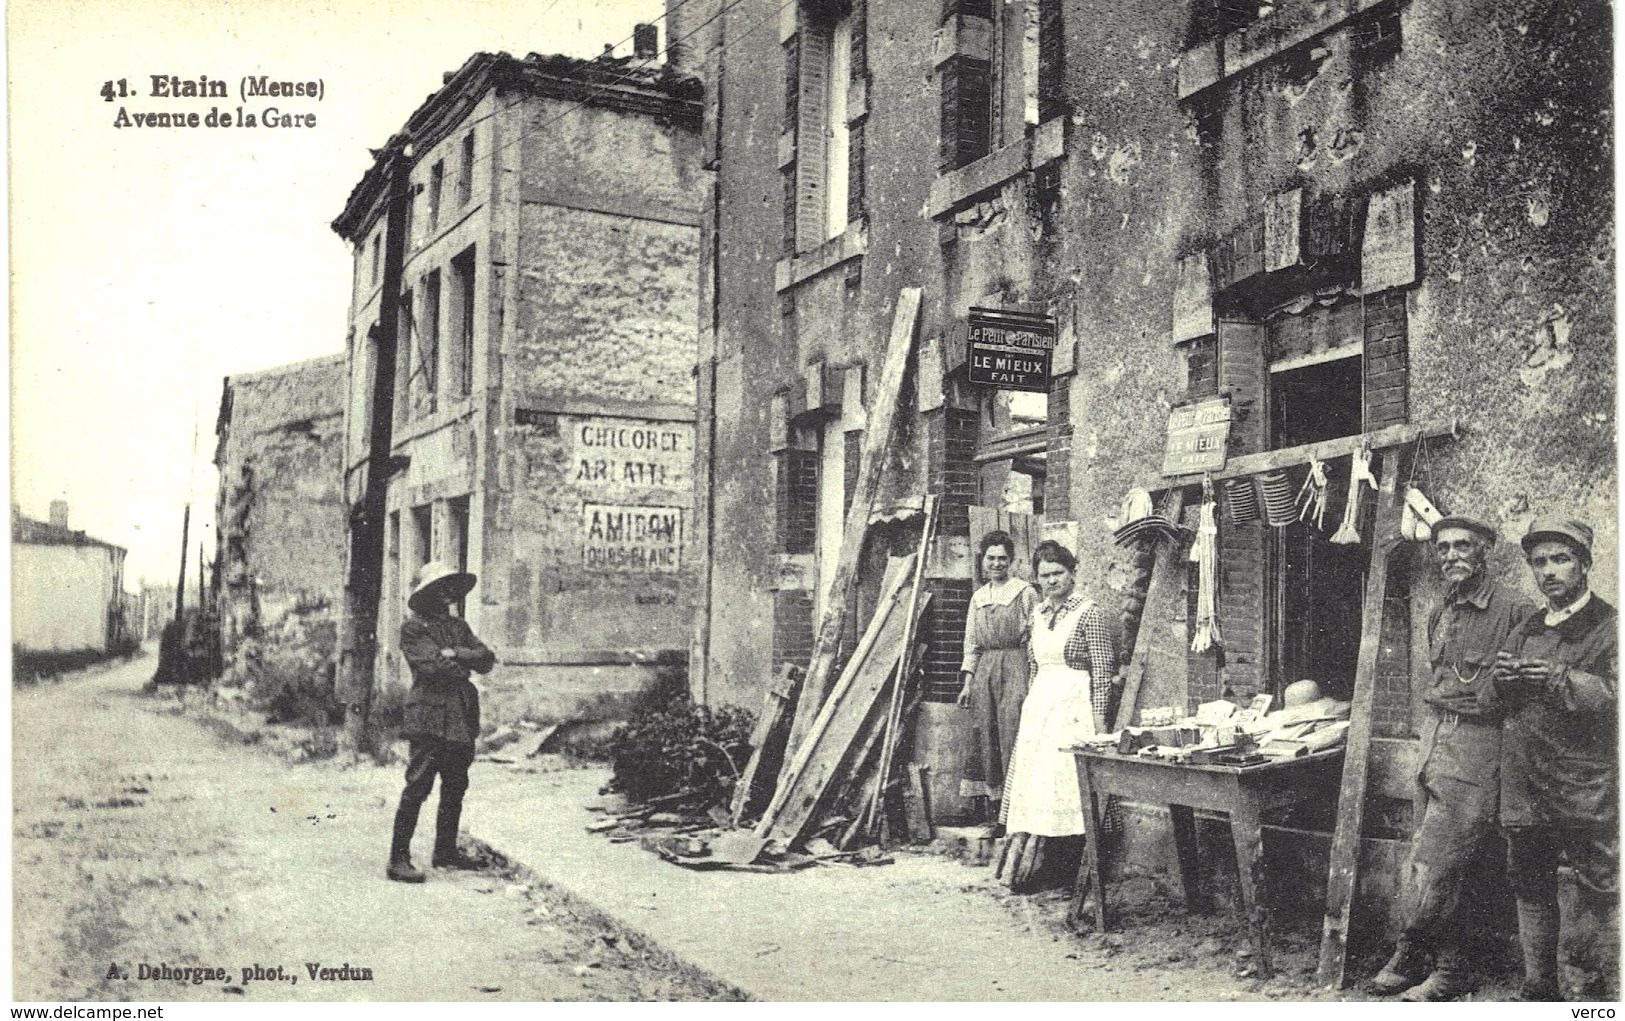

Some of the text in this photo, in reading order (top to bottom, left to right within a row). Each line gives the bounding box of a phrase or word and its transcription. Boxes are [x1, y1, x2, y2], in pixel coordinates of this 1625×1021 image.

[968, 326, 980, 341] Le
[982, 327, 1006, 344] Petit
[1015, 331, 1053, 349] Parisien
[974, 355, 1043, 374] LE MIEUX
[991, 372, 1026, 383] FAIT
